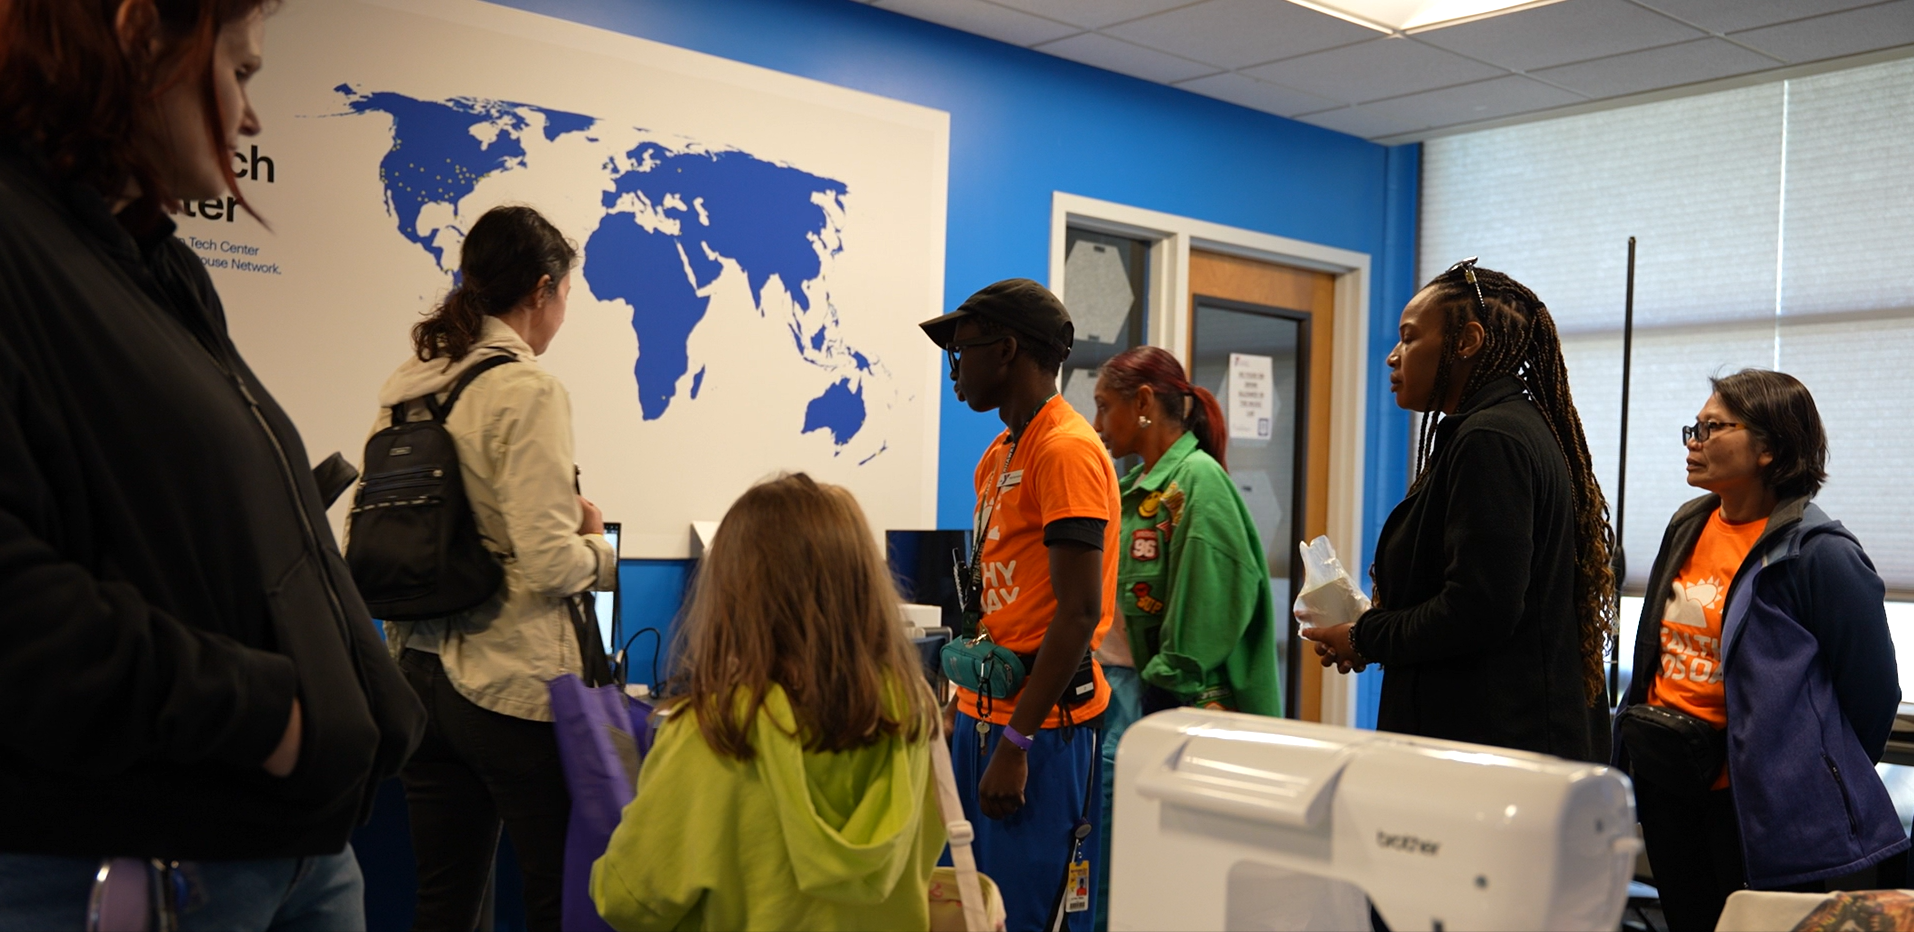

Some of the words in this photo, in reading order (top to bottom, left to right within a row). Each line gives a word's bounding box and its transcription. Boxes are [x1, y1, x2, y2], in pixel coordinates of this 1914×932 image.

[231, 144, 275, 183] ch
[181, 194, 243, 223] ter
[189, 236, 217, 251] Tech
[220, 240, 260, 256] Center
[200, 255, 229, 269] ouse
[231, 258, 282, 275] Network.
[1133, 538, 1158, 558] 96
[981, 560, 1017, 589] HY
[981, 586, 1020, 615] AY
[1660, 627, 1721, 661] EALTH
[1376, 829, 1441, 856] brother
